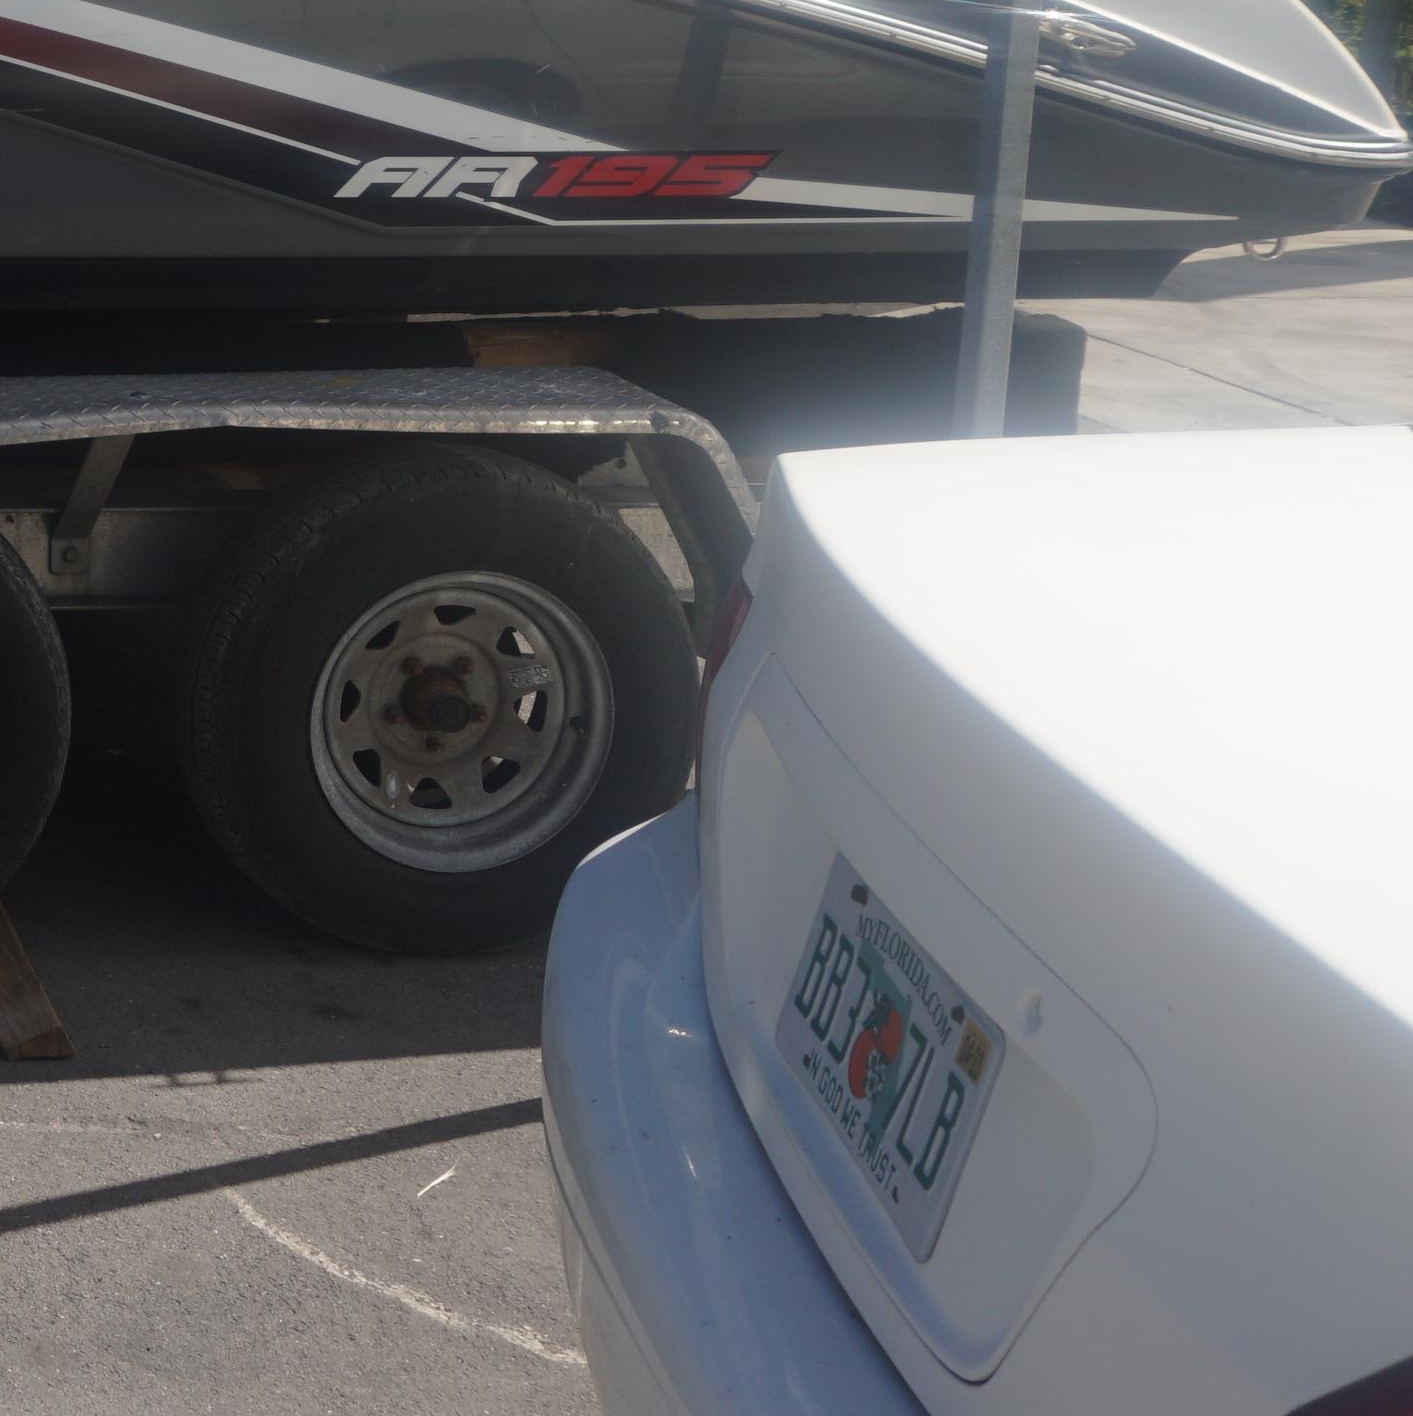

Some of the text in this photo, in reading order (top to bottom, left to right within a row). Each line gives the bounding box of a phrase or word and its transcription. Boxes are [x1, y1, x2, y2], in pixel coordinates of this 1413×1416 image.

[856, 914, 952, 1045] MYFLORIDA.COM
[808, 1050, 896, 1191] IN GOD WE TRUST
